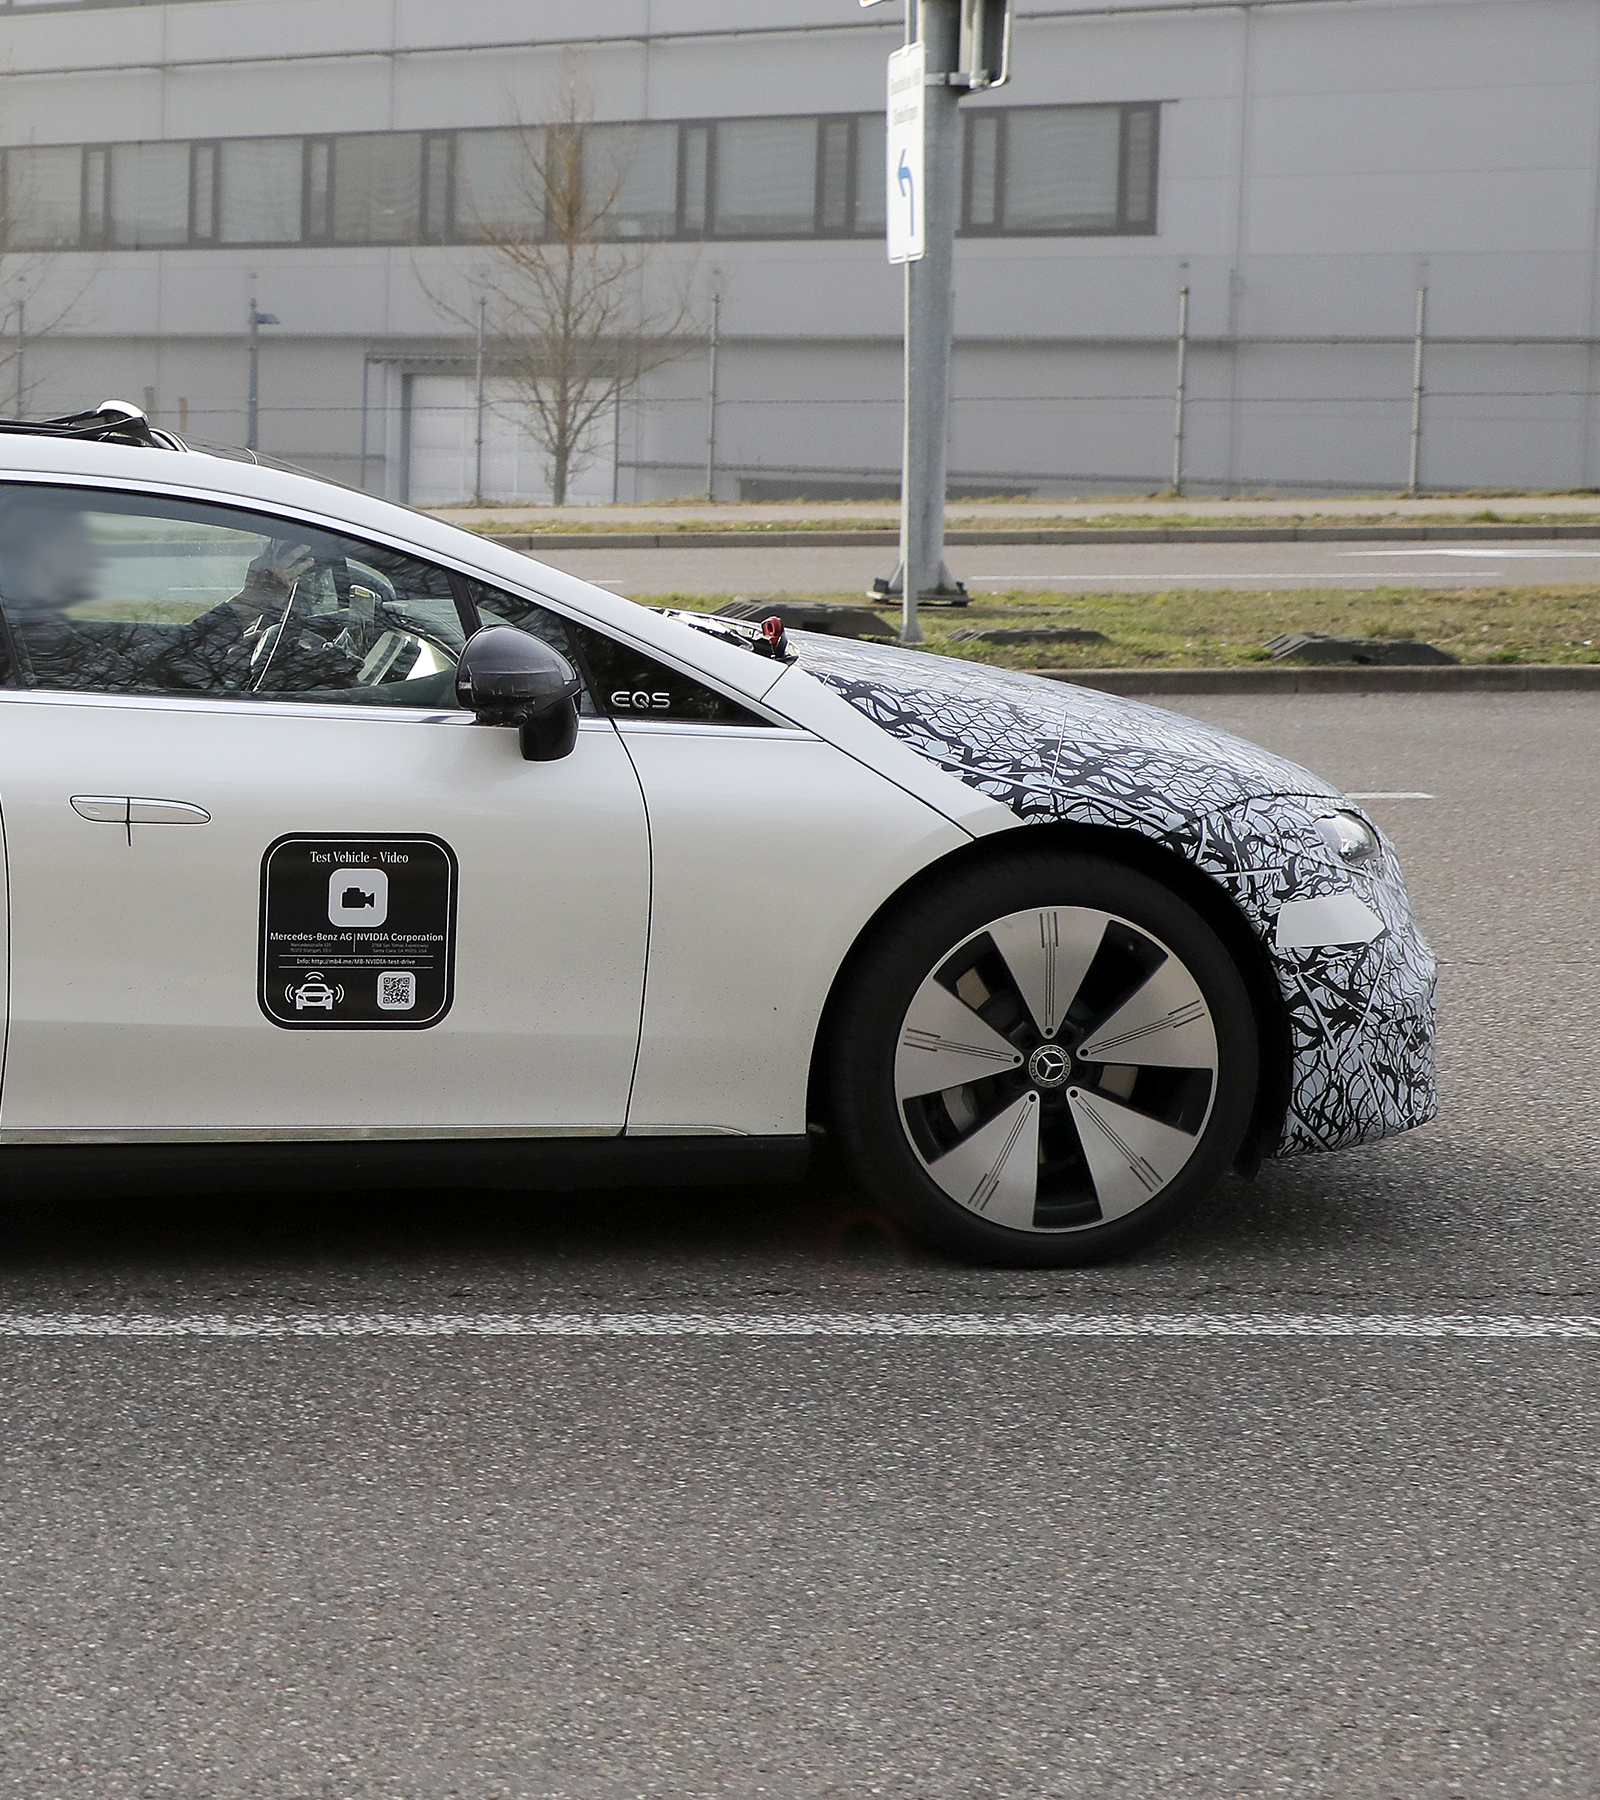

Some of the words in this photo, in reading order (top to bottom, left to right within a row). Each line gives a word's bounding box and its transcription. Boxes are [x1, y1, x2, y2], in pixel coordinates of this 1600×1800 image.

[611, 691, 671, 709] EQS
[310, 851, 331, 863] Test
[333, 851, 370, 864] Vehicle
[380, 852, 409, 864] Video
[270, 932, 338, 941] Mercedes-Benz
[339, 932, 353, 941] AG
[357, 933, 389, 941] NVIDIA
[391, 933, 444, 943] Corporation
